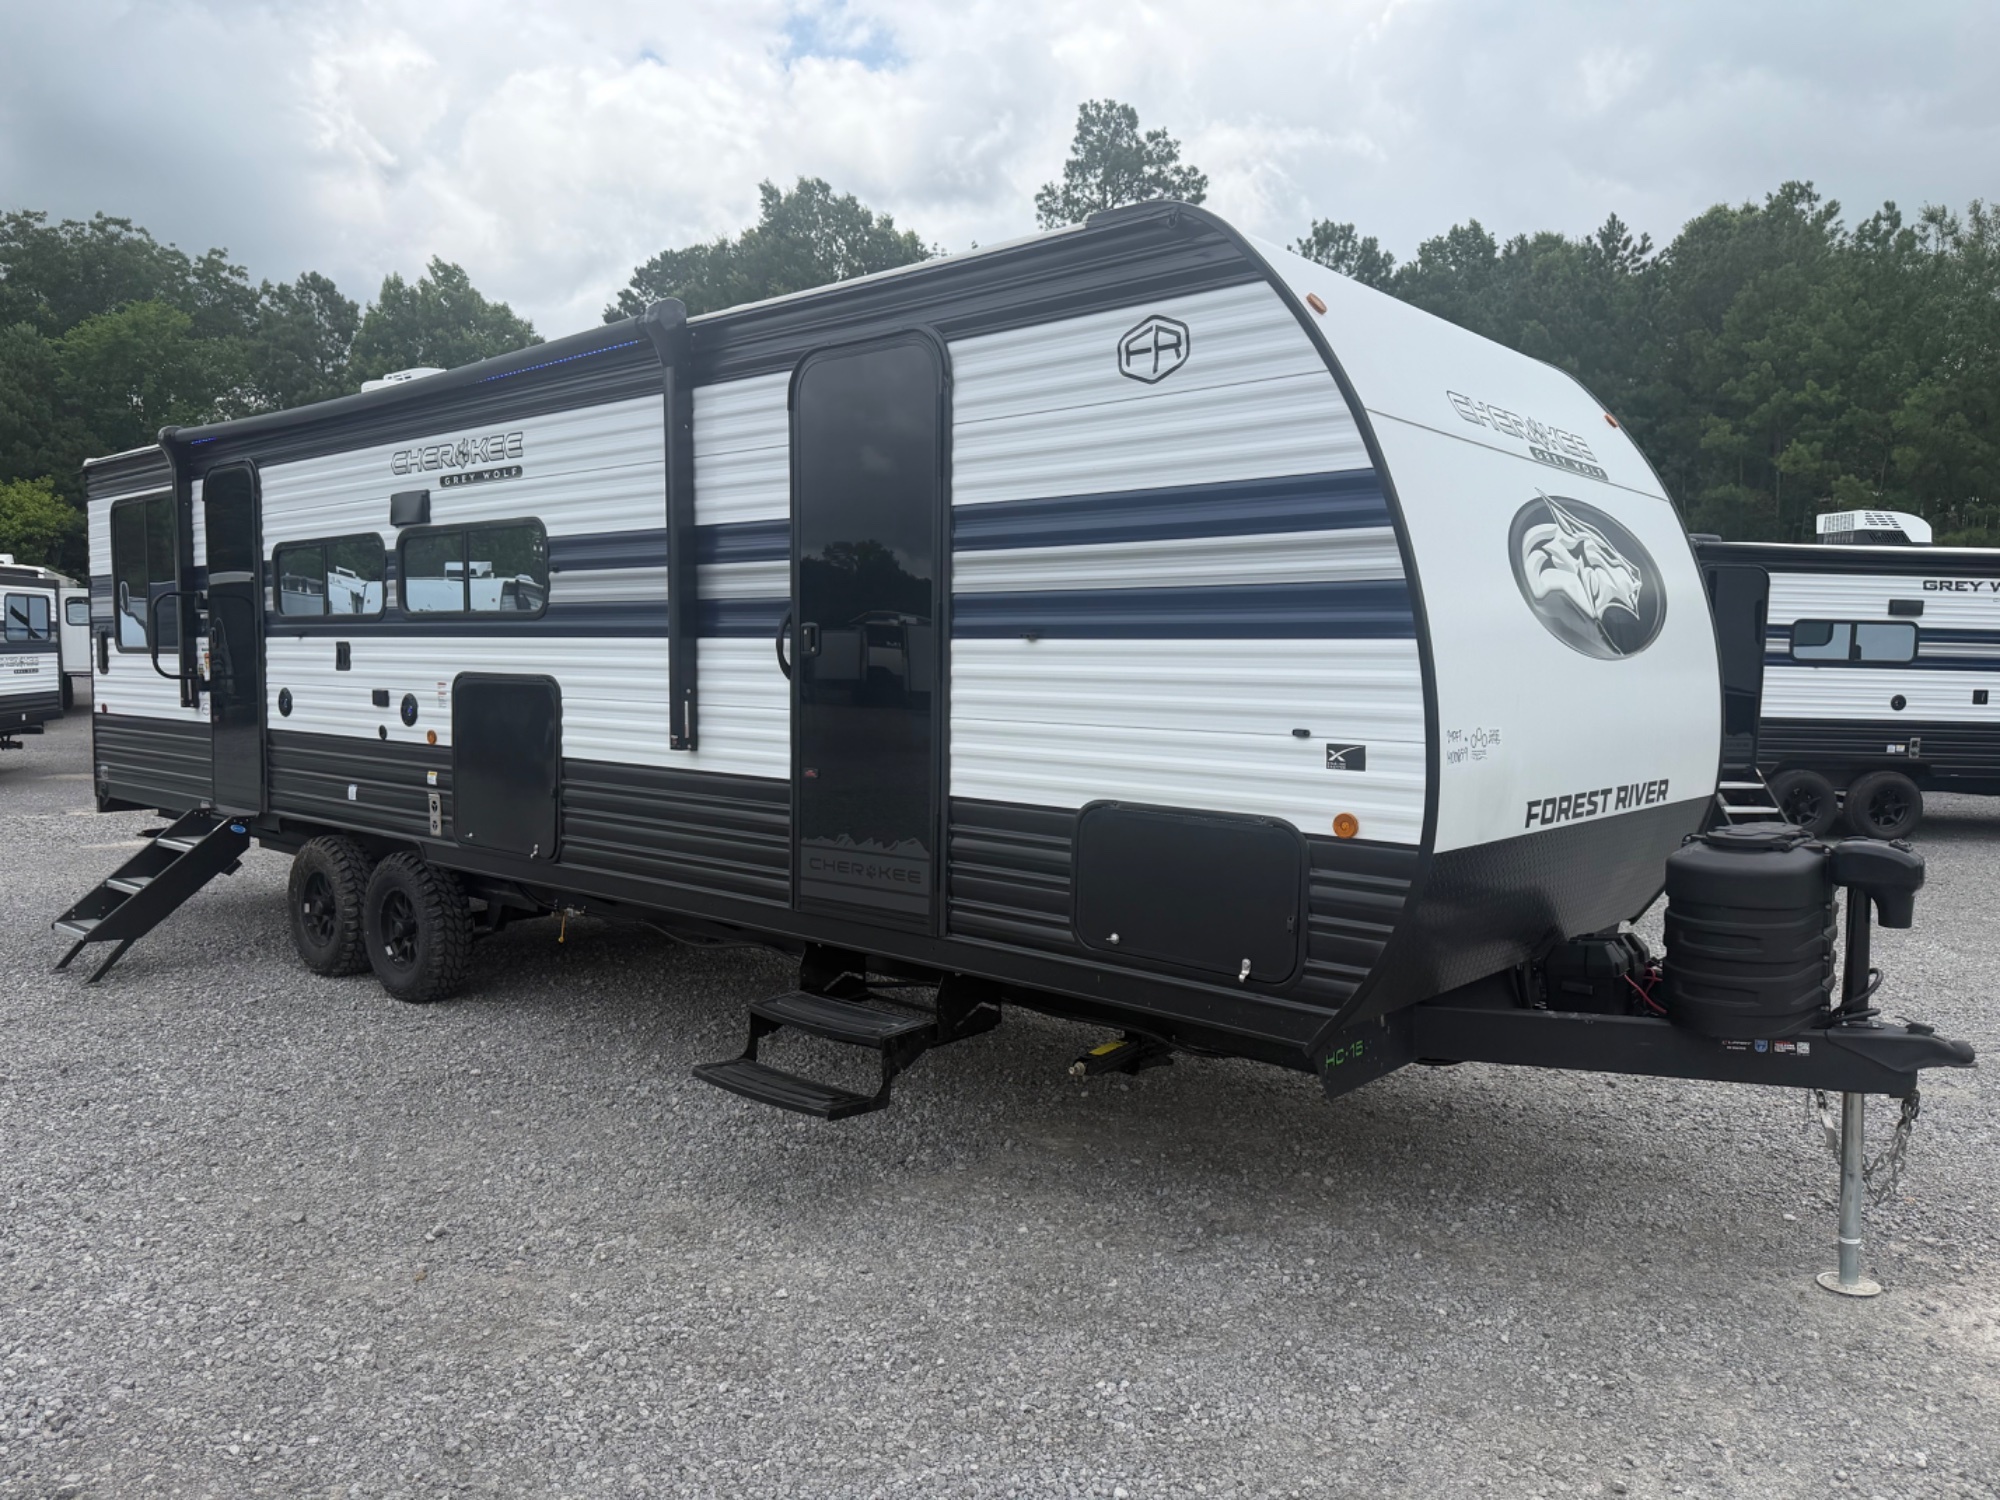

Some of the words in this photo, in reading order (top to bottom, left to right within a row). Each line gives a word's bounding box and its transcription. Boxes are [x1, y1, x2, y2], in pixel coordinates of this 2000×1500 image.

[444, 473, 475, 485] GREY
[482, 467, 518, 480] WOLF
[1922, 580, 1985, 592] GREY
[1525, 787, 1613, 829] FOREST
[1614, 778, 1669, 811] RIVER
